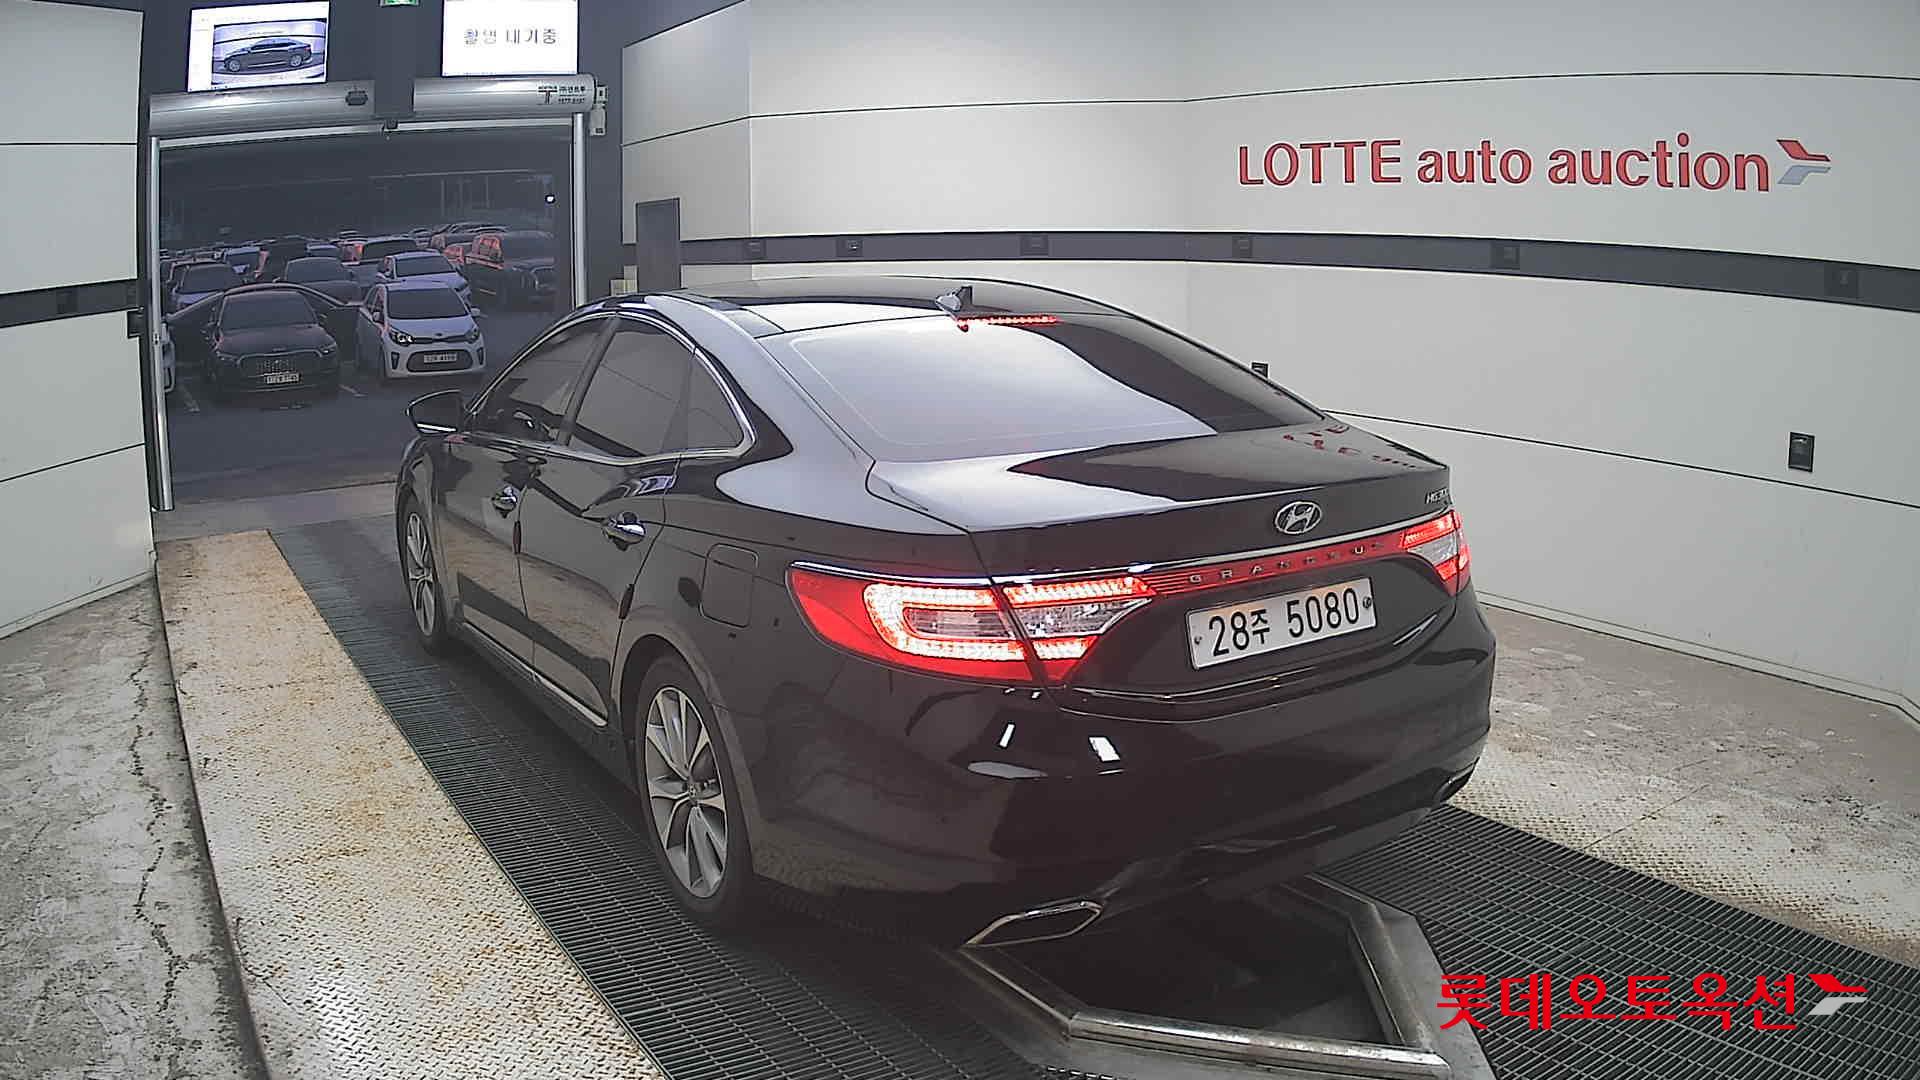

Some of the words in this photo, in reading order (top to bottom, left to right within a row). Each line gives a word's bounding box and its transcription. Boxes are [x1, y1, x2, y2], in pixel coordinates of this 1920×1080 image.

[1239, 140, 1401, 186] LOTTE
[1417, 140, 1532, 185] auto
[1548, 132, 1770, 193] auction
[1209, 610, 1270, 657] 28주
[1287, 587, 1360, 639] 5080
